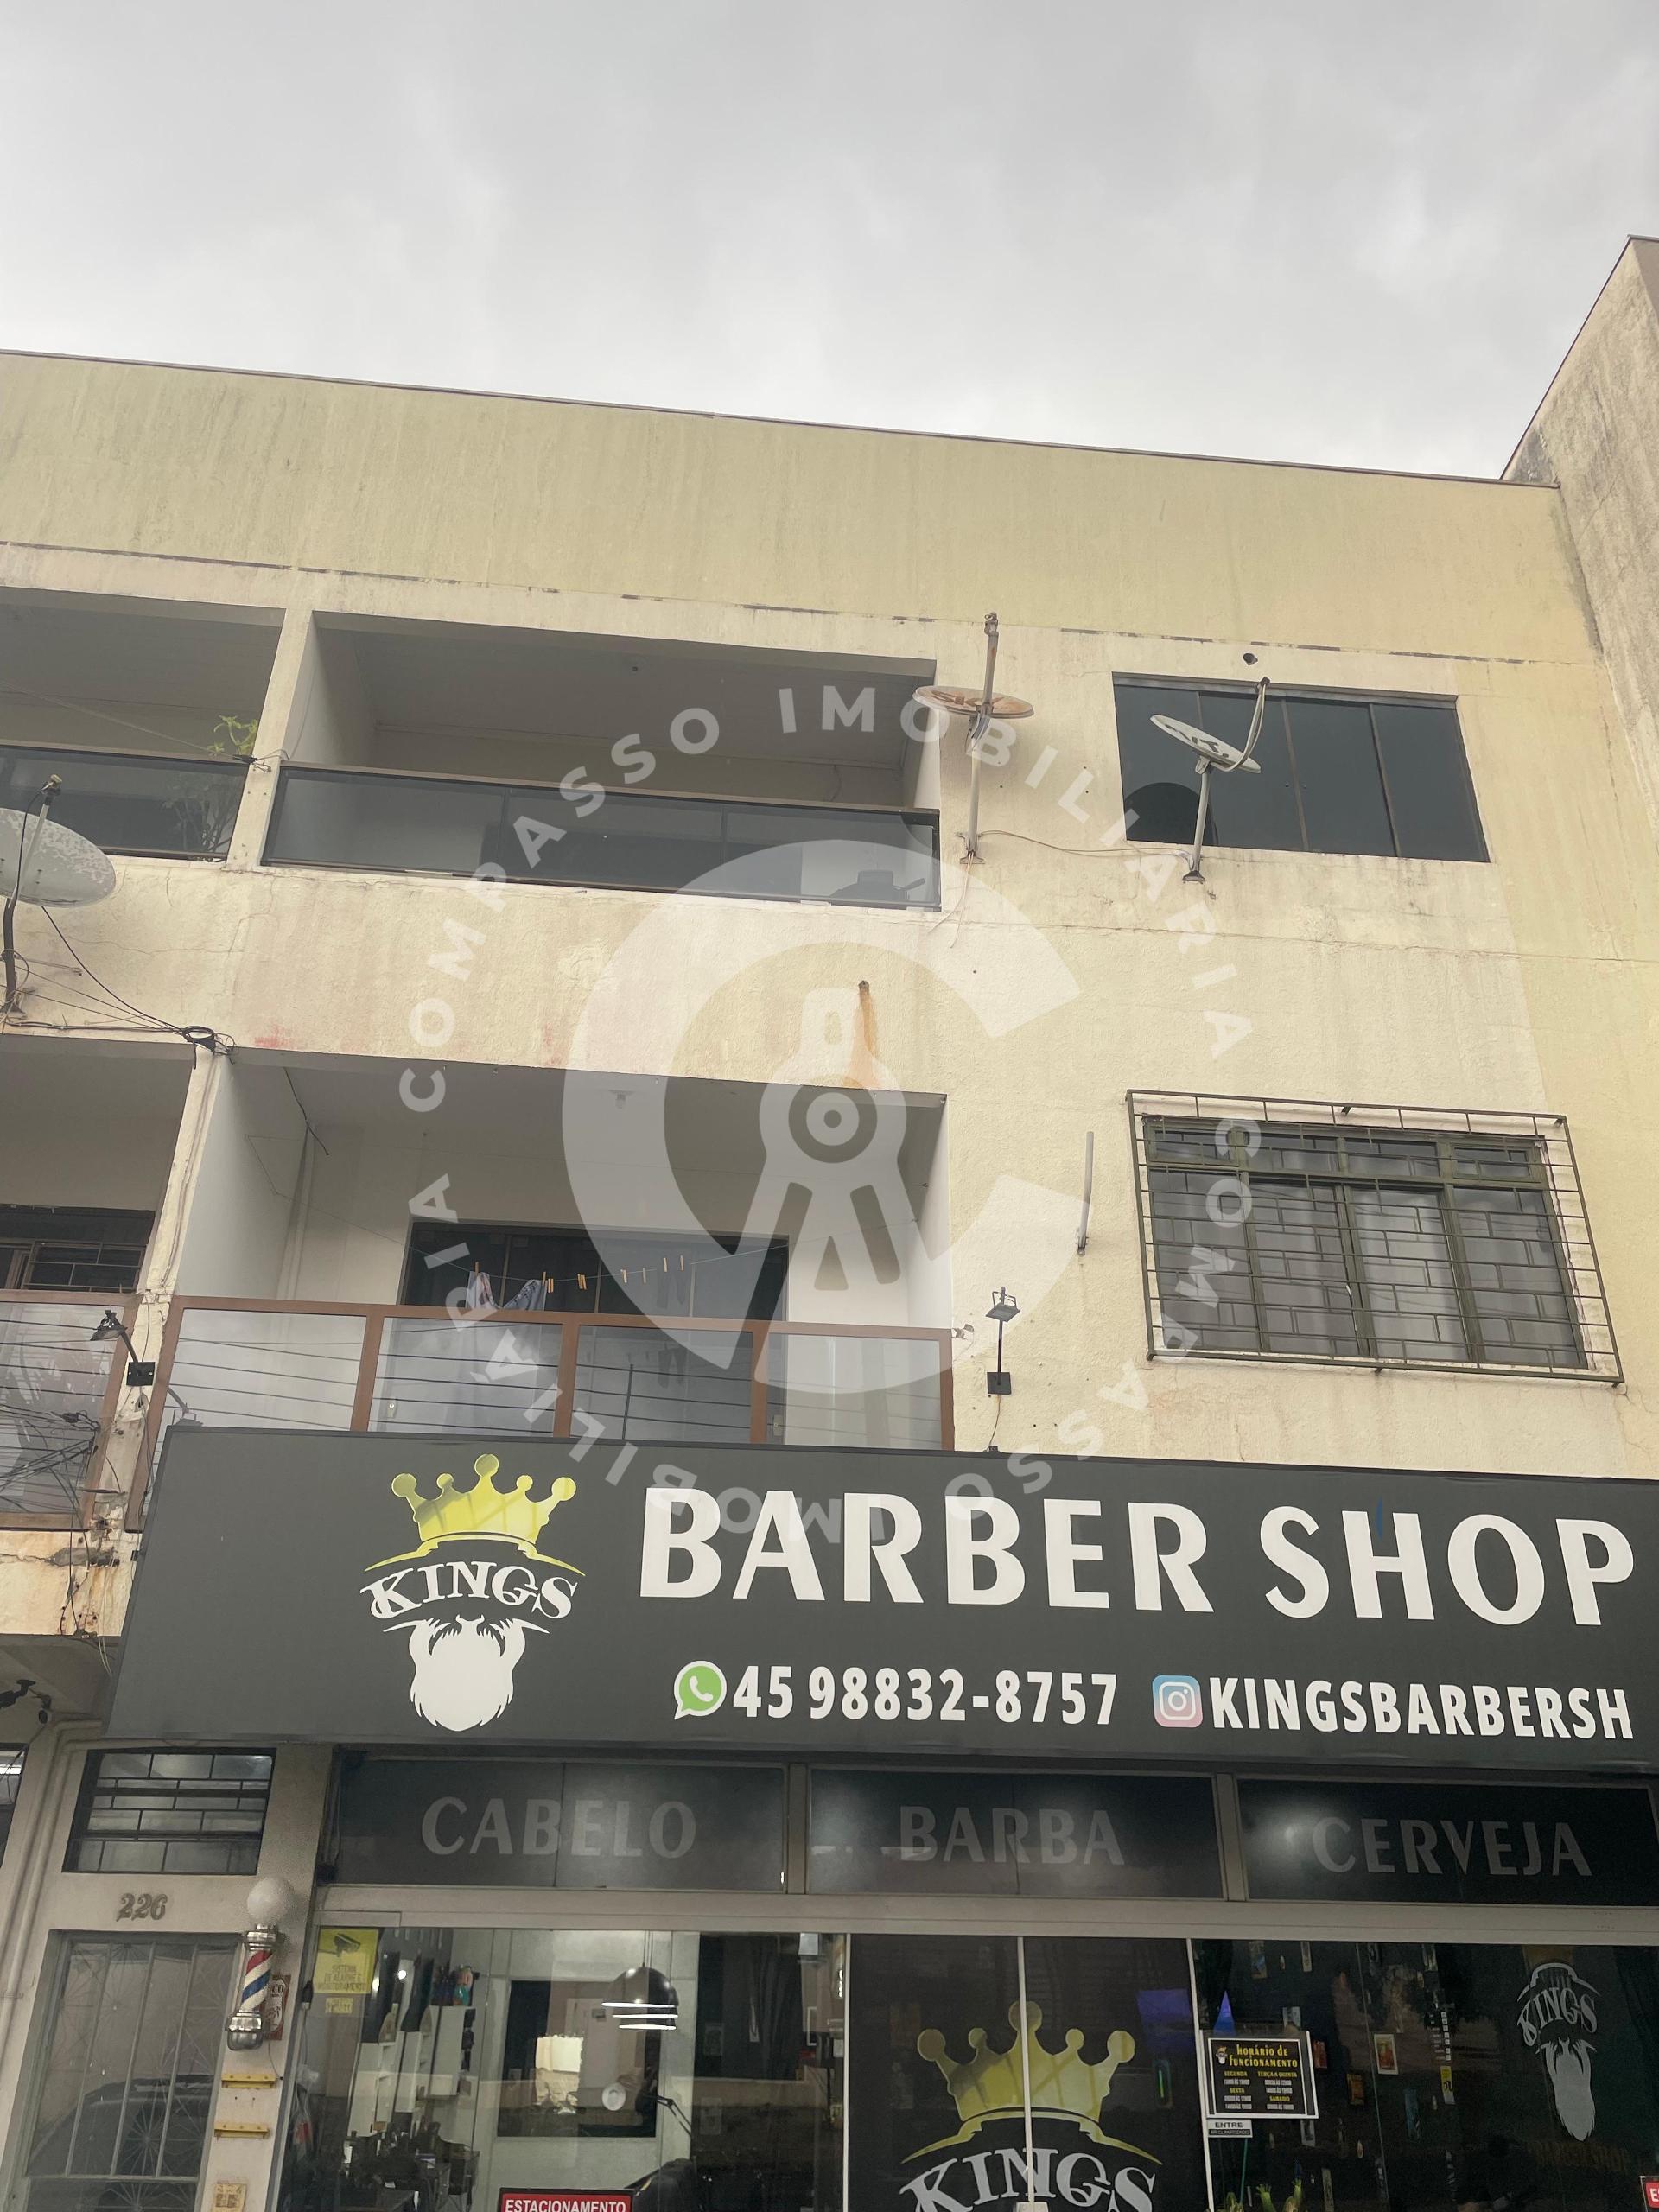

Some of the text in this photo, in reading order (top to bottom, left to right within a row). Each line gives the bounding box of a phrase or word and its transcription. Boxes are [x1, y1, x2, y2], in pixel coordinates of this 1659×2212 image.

[639, 1487, 1635, 1626] BARBER SHOP
[359, 1560, 578, 1619] KINGS
[733, 1665, 1117, 1726] 45 98832-8757
[1209, 1676, 1634, 1740] KINGSBARBERSH
[421, 1796, 697, 1859] CABELO
[899, 1805, 1125, 1866] BARBA
[1313, 1816, 1593, 1877] CERVEJA
[116, 1892, 168, 1923] 226
[1516, 1987, 1598, 2046] KINGS
[505, 2199, 626, 2212] ESTACIONAMENTO
[899, 2147, 1156, 2212] KINGS
